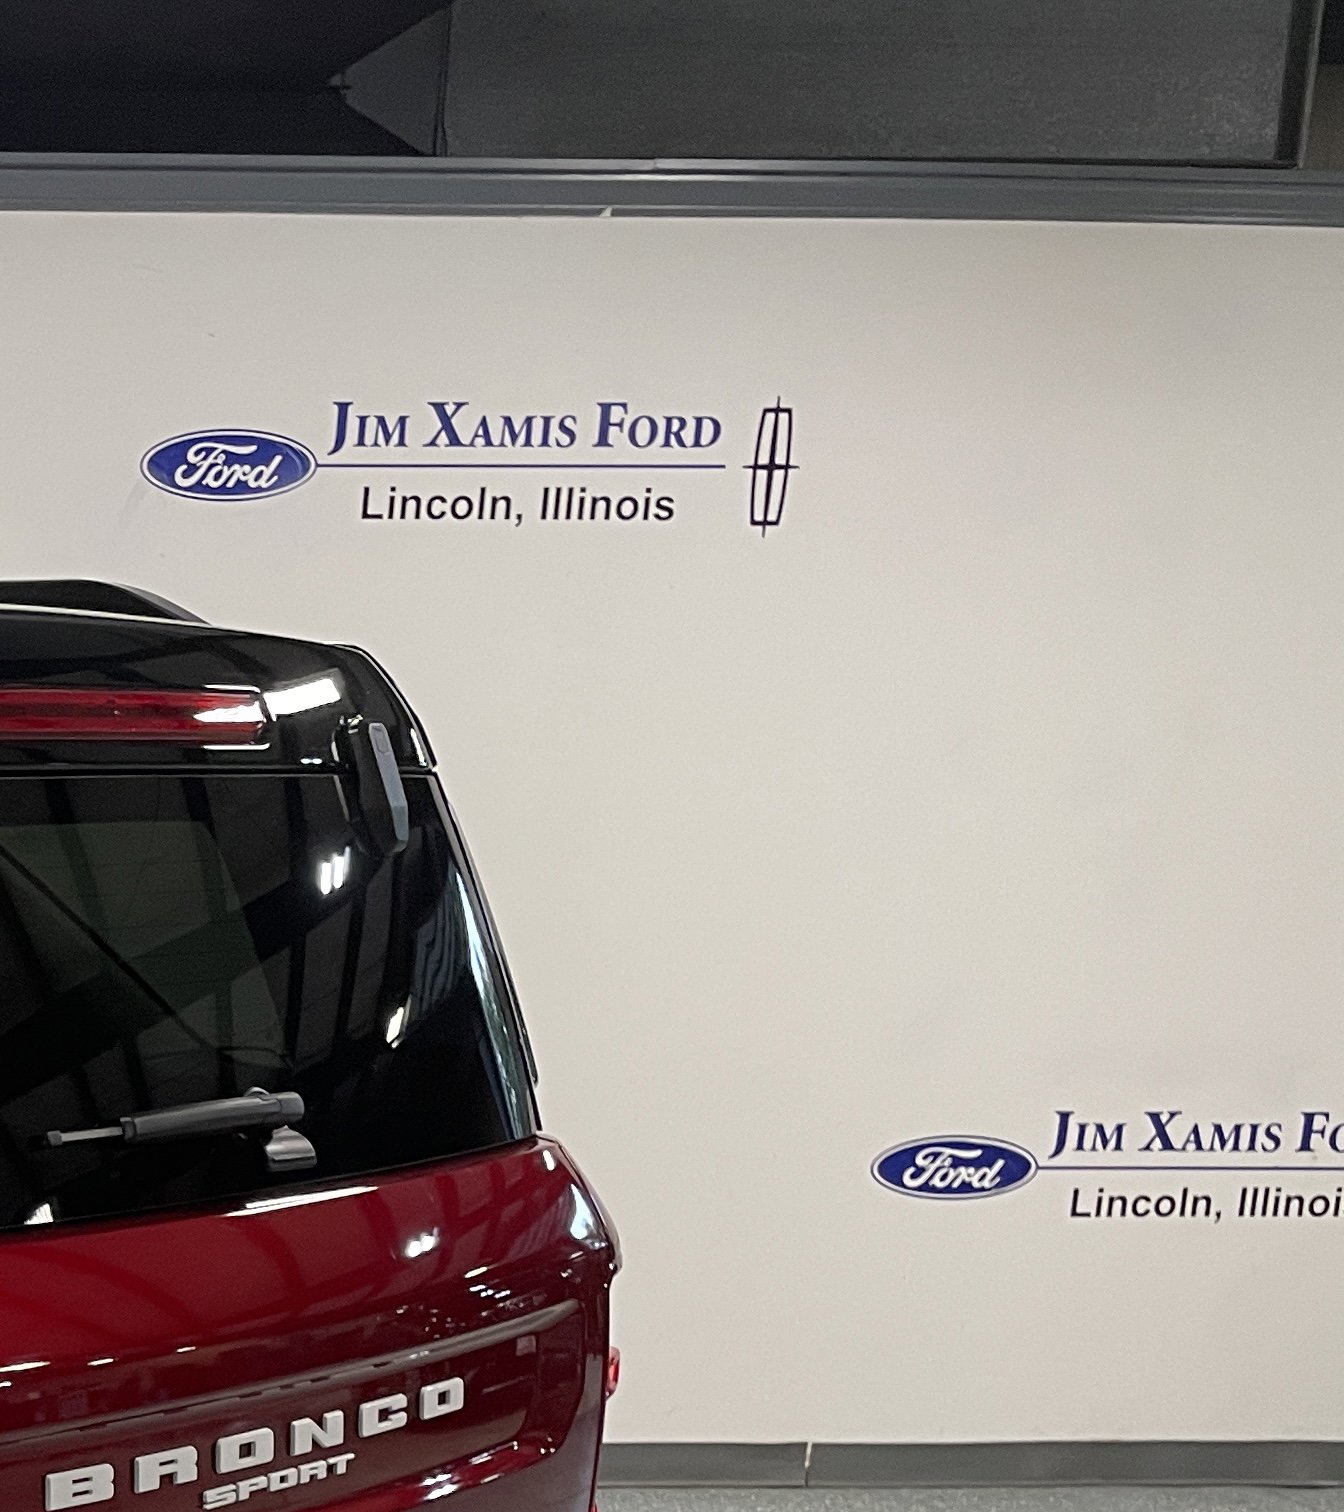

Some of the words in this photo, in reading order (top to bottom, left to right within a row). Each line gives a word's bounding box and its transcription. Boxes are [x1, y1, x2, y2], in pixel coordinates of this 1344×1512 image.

[327, 401, 410, 456] JIM
[423, 401, 577, 449] XAMIS
[592, 402, 723, 449] FORD
[361, 486, 523, 528] Lincoln,
[540, 486, 676, 521] Illinois
[1048, 1110, 1126, 1160] JIM
[1138, 1110, 1282, 1153] XAMIS
[1070, 1186, 1222, 1224] Lincoln,
[1239, 1186, 1344, 1219] Illinoi
[44, 1376, 465, 1512] BRONCO
[202, 1451, 357, 1511] SPORT
